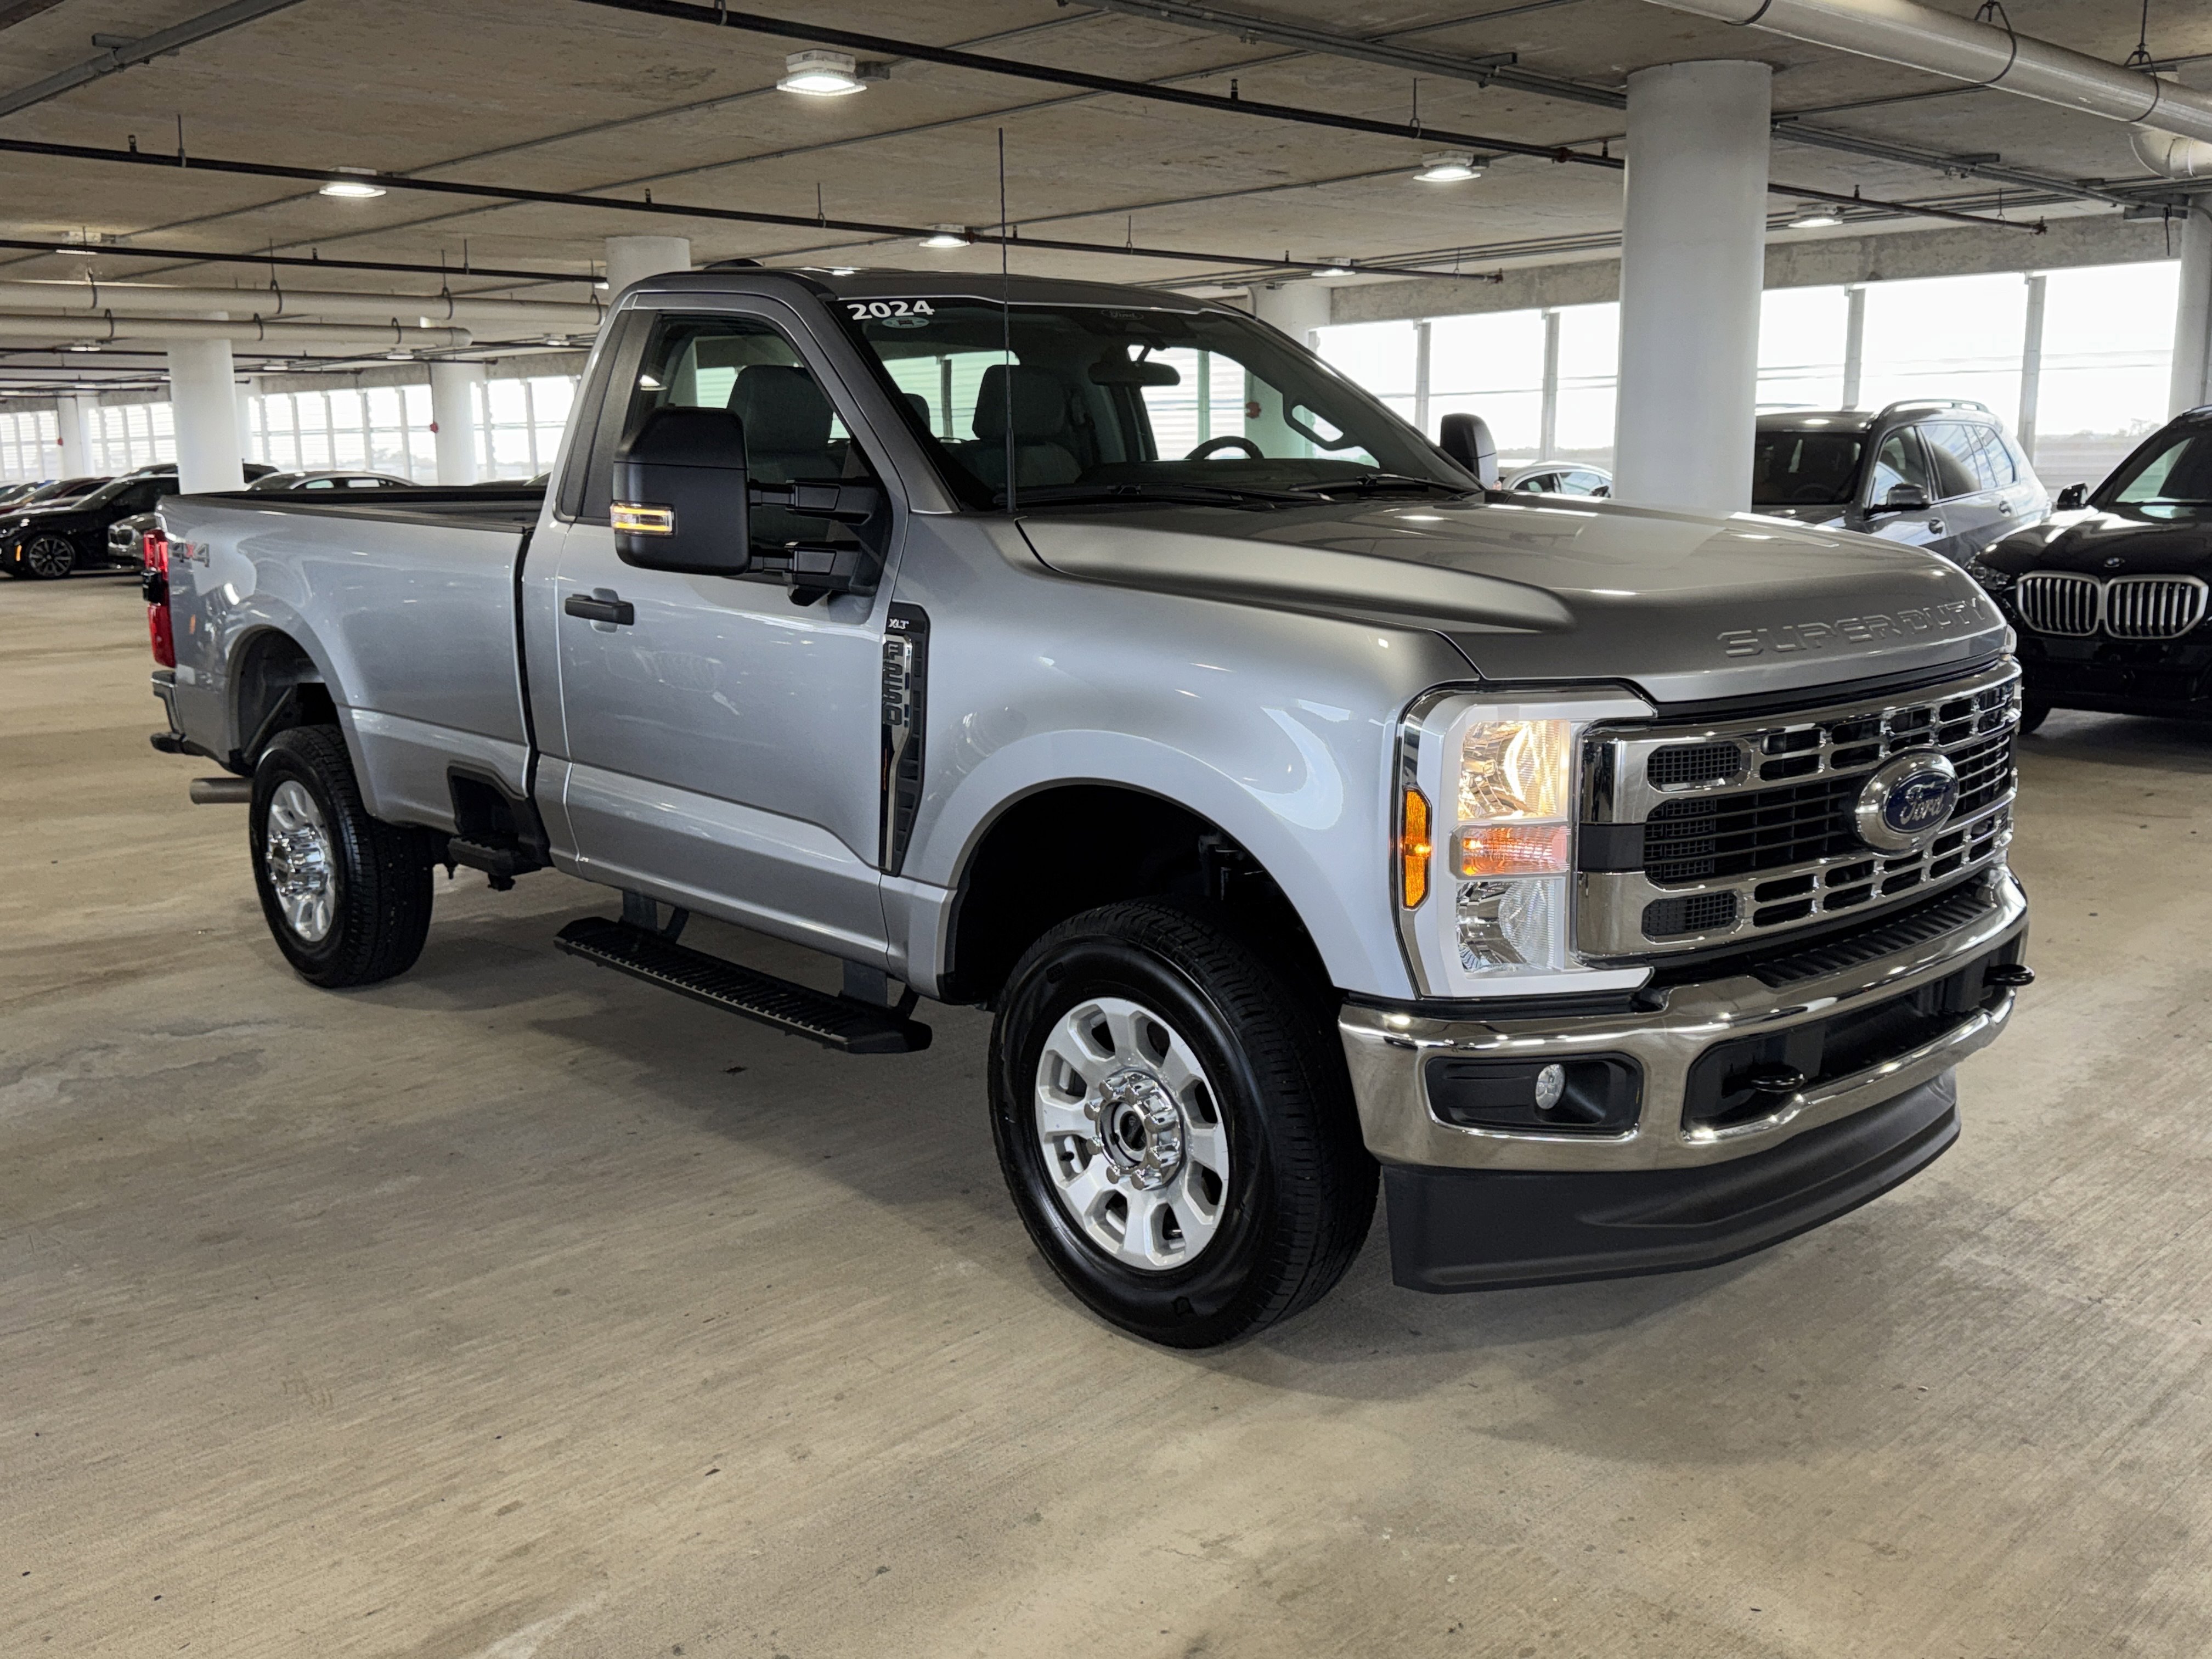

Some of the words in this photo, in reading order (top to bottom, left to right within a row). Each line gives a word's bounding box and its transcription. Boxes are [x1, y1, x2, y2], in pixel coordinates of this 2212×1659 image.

[847, 300, 935, 320] 2024
[888, 618, 910, 630] XLT
[1717, 614, 1901, 658] SUPER
[1897, 597, 1986, 635] DUTY
[1899, 781, 1946, 825] Ford
